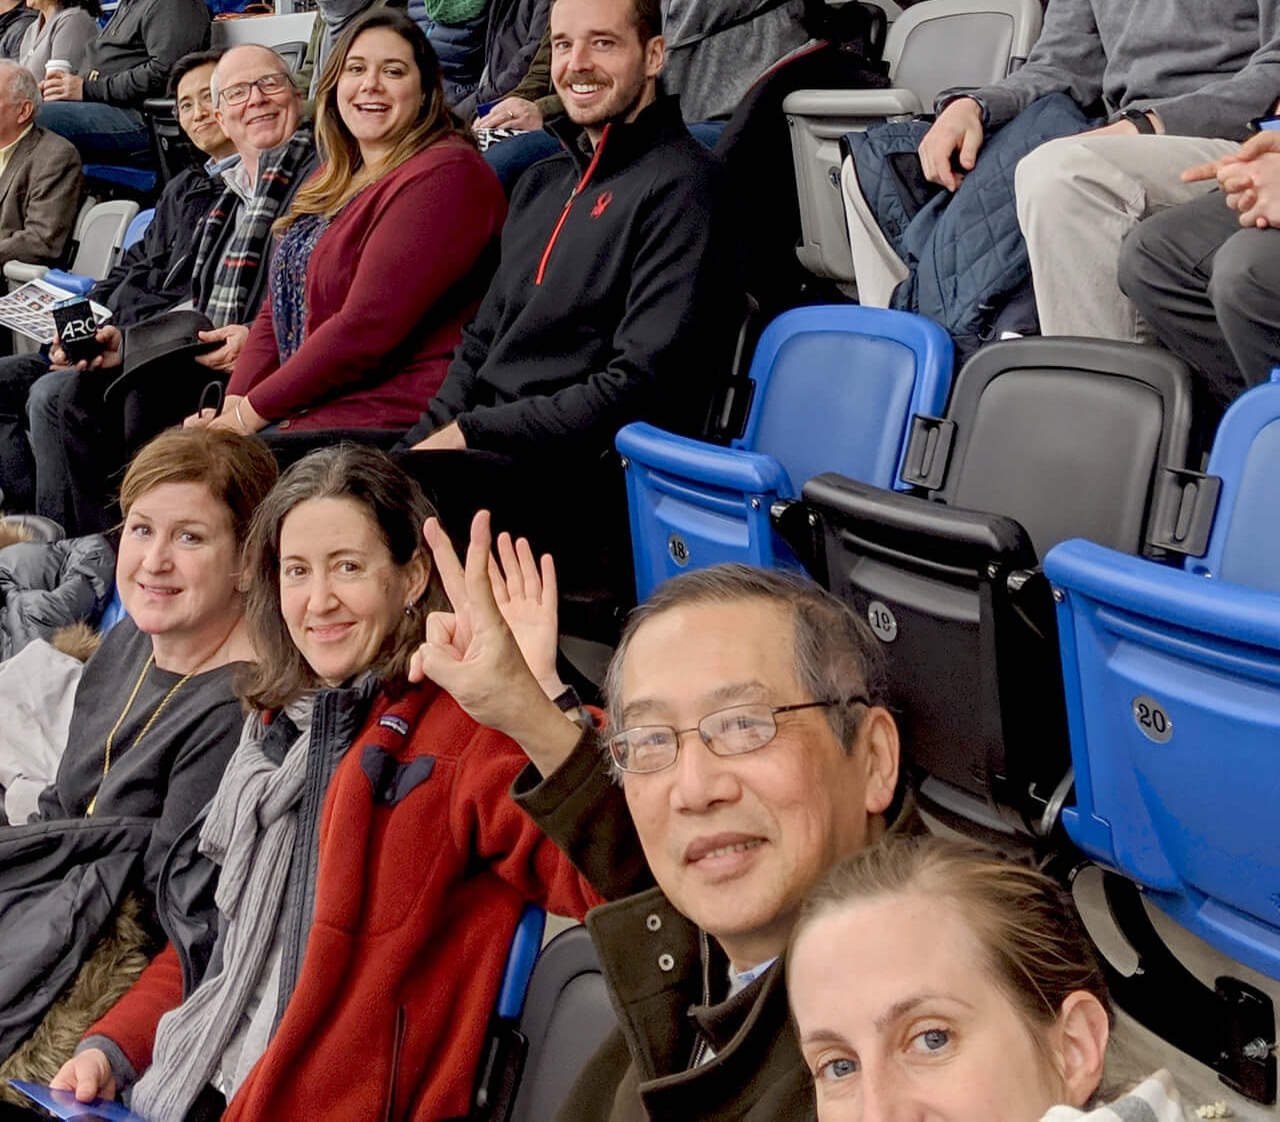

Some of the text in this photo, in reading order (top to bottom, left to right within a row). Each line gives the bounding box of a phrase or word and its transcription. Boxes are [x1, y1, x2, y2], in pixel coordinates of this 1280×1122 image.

[60, 316, 98, 340] ARC
[671, 539, 687, 560] 18
[874, 608, 891, 632] 19
[1138, 702, 1167, 734] 20
